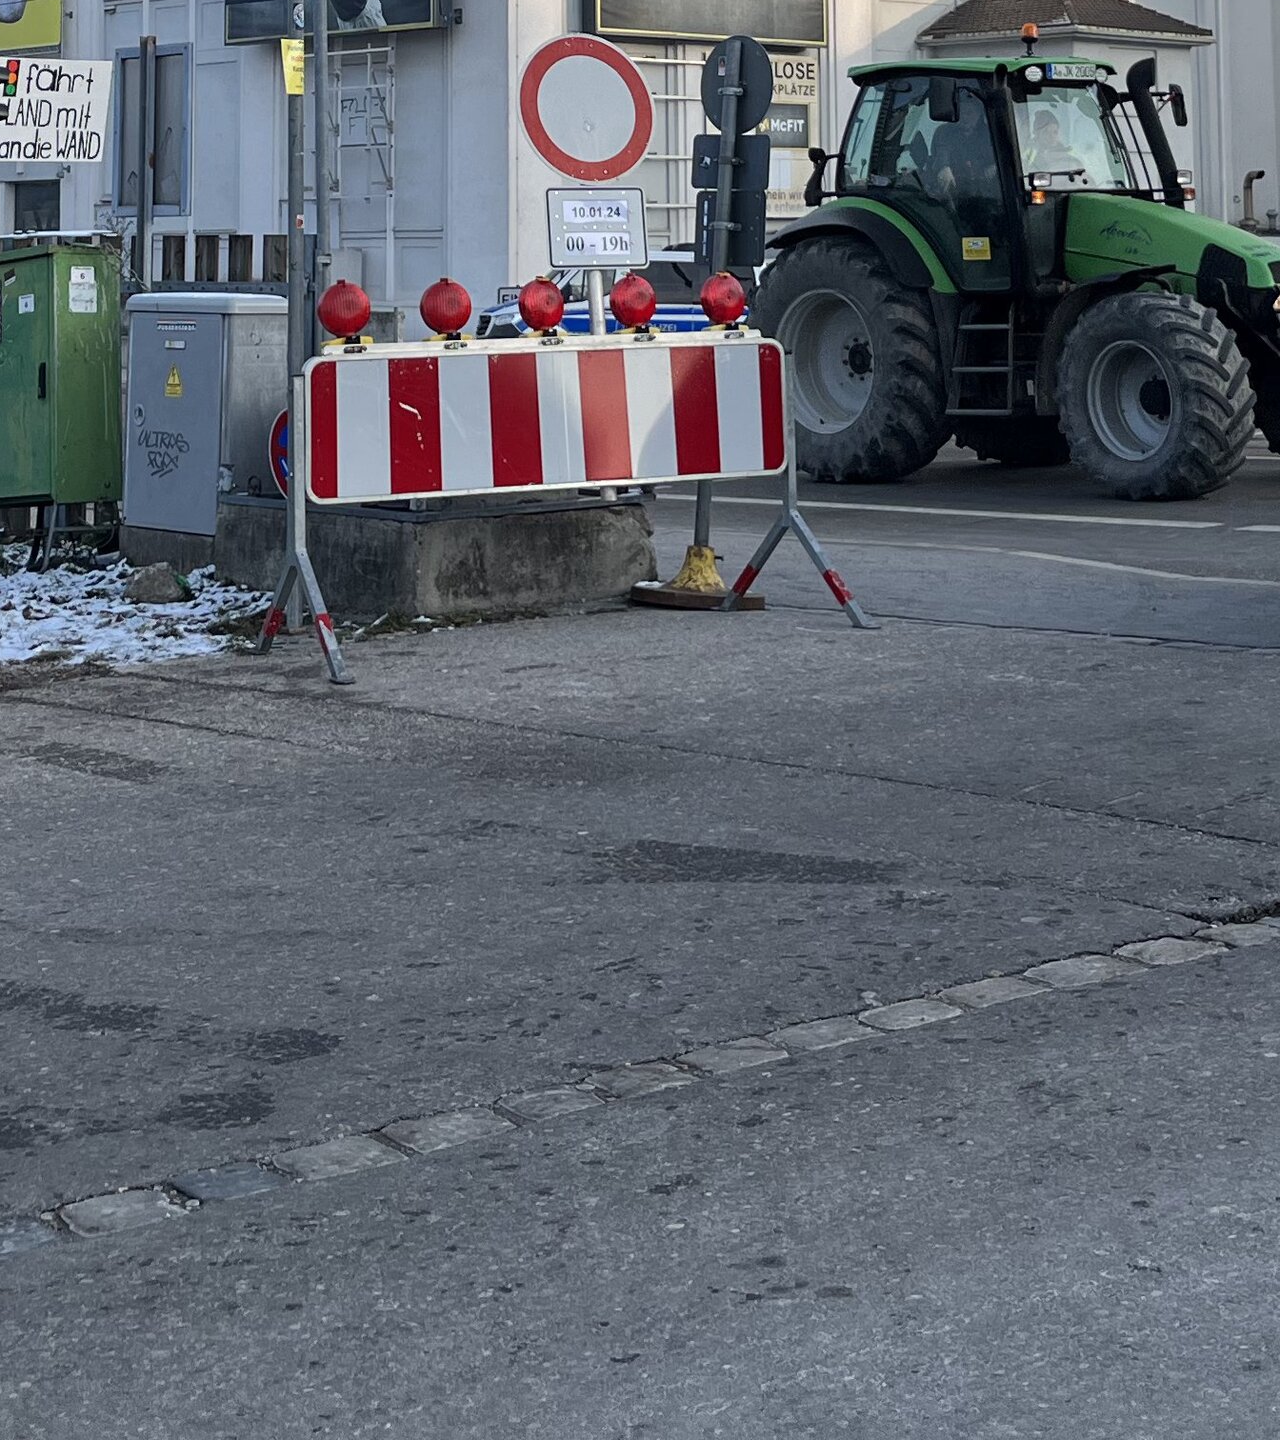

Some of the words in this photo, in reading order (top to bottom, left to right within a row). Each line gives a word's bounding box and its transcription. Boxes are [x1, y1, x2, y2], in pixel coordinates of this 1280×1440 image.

[26, 63, 94, 94] fährt
[774, 61, 816, 80] LOSE
[5, 98, 52, 127] LAND
[771, 118, 805, 132] McFIT
[56, 130, 101, 160] WAND
[571, 206, 621, 218] 10.01.24
[566, 236, 585, 252] 00
[602, 236, 629, 252] 19h
